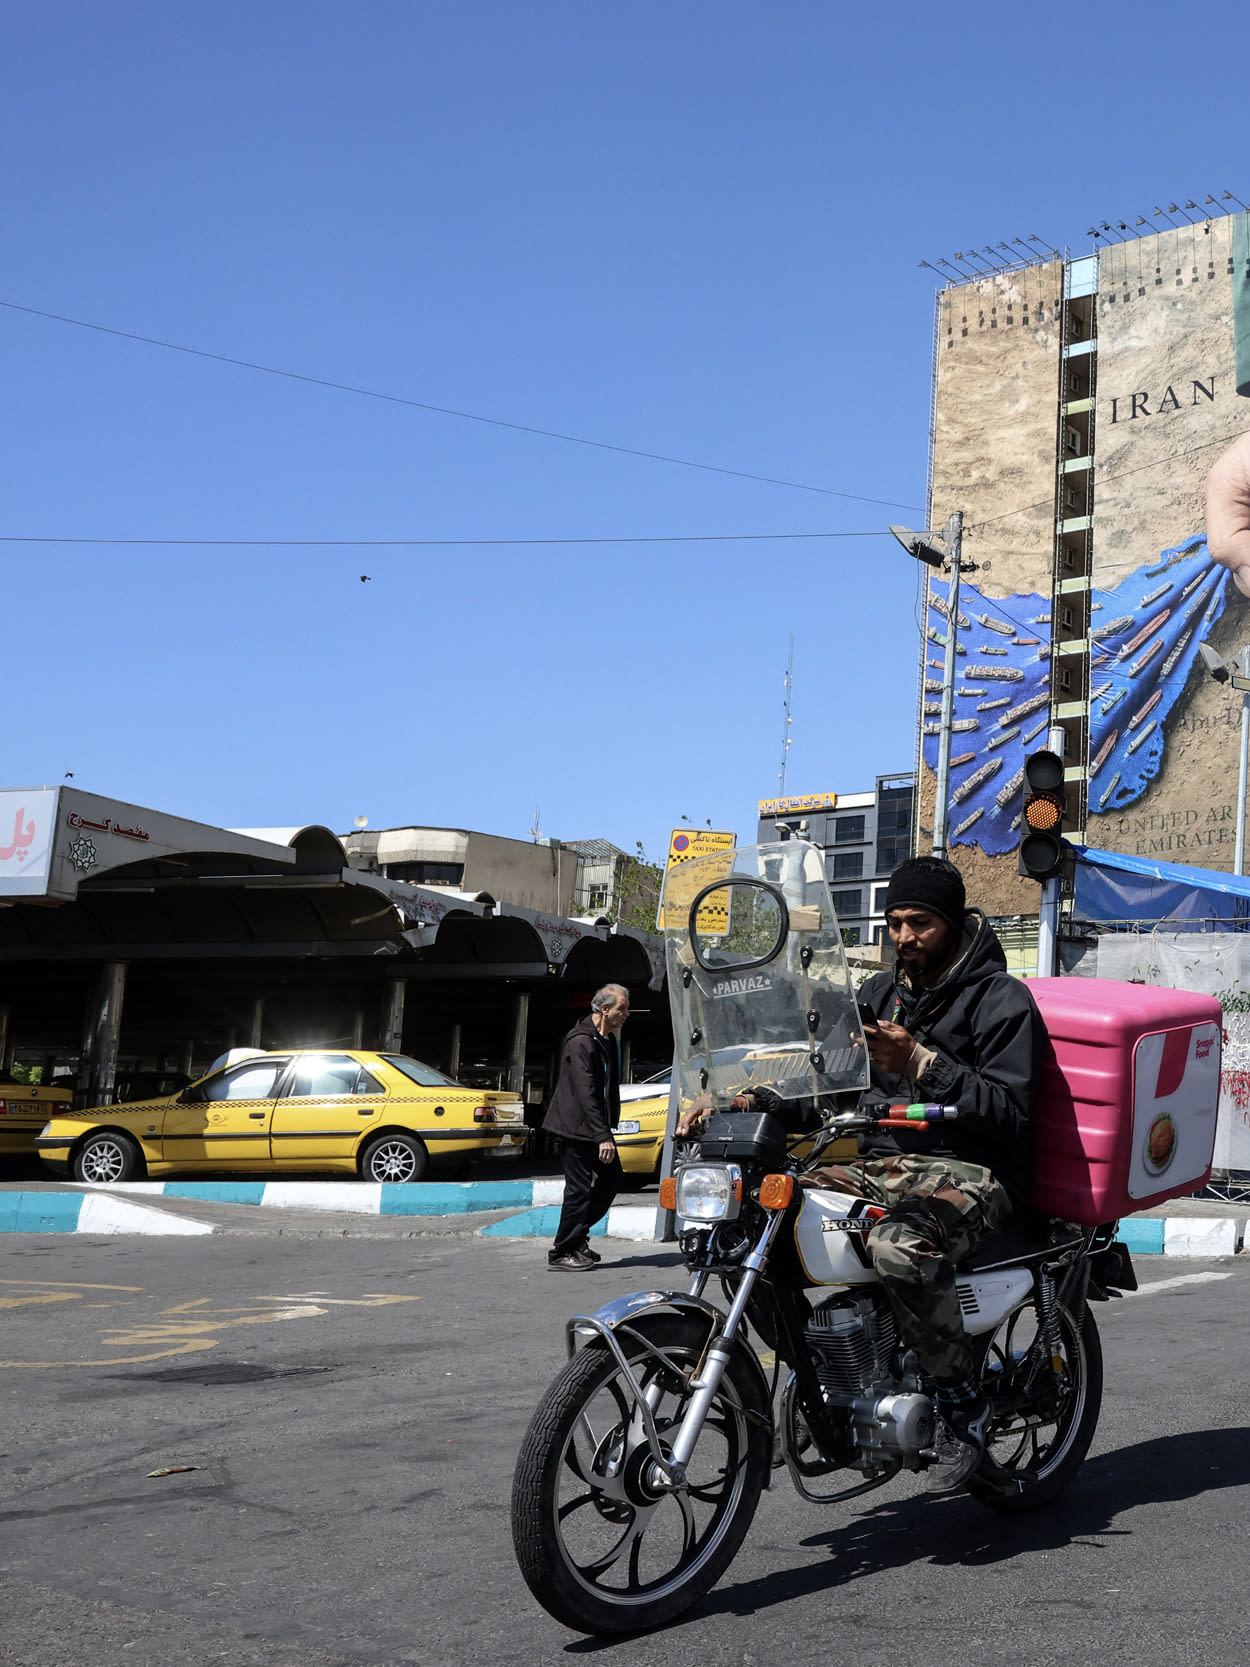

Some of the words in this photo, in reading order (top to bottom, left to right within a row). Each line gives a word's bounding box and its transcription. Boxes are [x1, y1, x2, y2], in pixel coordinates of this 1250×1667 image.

[1110, 376, 1219, 424] IRAN
[112, 822, 151, 841] مقصد
[1118, 809, 1198, 835] UNITED
[717, 976, 764, 995] PARVAZ
[1196, 1046, 1210, 1060] Food
[822, 1219, 874, 1231] HOND
